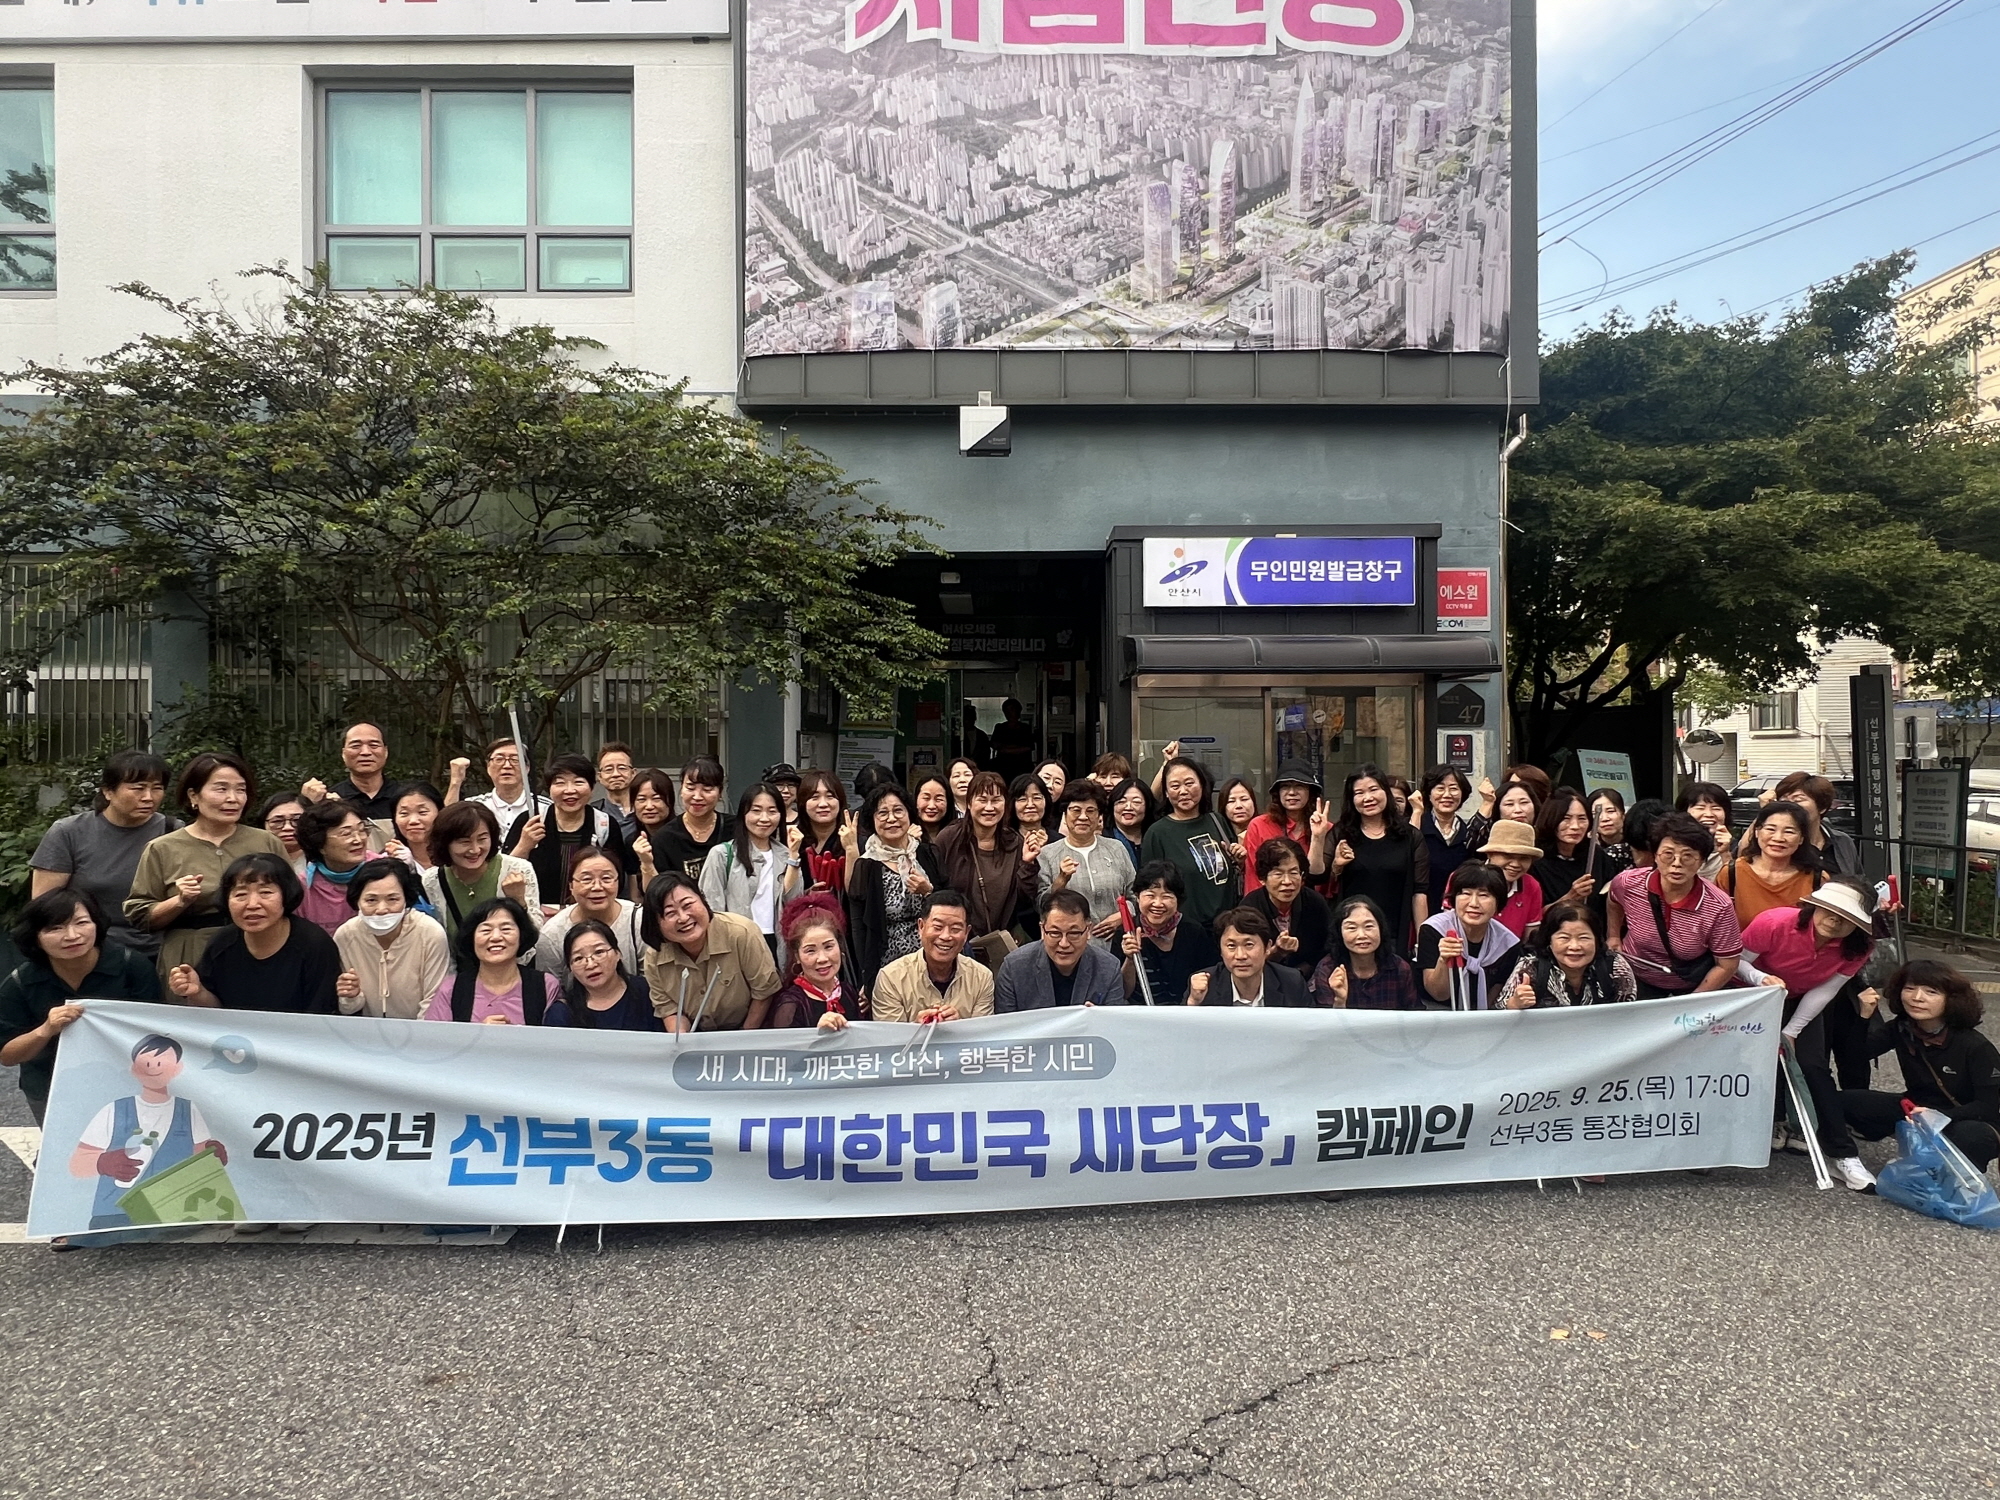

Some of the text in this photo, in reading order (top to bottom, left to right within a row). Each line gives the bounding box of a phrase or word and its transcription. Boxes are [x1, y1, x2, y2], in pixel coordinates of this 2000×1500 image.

[1250, 560, 1403, 583] 무인민원발급창구
[1167, 587, 1202, 597] 안산시
[1439, 584, 1478, 600] 에스원
[942, 623, 996, 635] 어서오세요
[1437, 619, 1463, 628] ECOM
[950, 638, 1046, 653] 정복지센터입니다
[1458, 704, 1483, 723] 47
[1869, 717, 1881, 765] 선부3동
[1740, 1022, 1766, 1034] 안산
[696, 1041, 1095, 1086] 새 시대, 깨끗한 안산, 행복한 시민
[1498, 1073, 1751, 1117] 2025. 9. 25.(목) 17:00
[1489, 1110, 1702, 1148] 선부3동 통장협의회
[252, 1101, 1474, 1188] 2025년 선부3동 「대한민국 새단장」 캠페인
